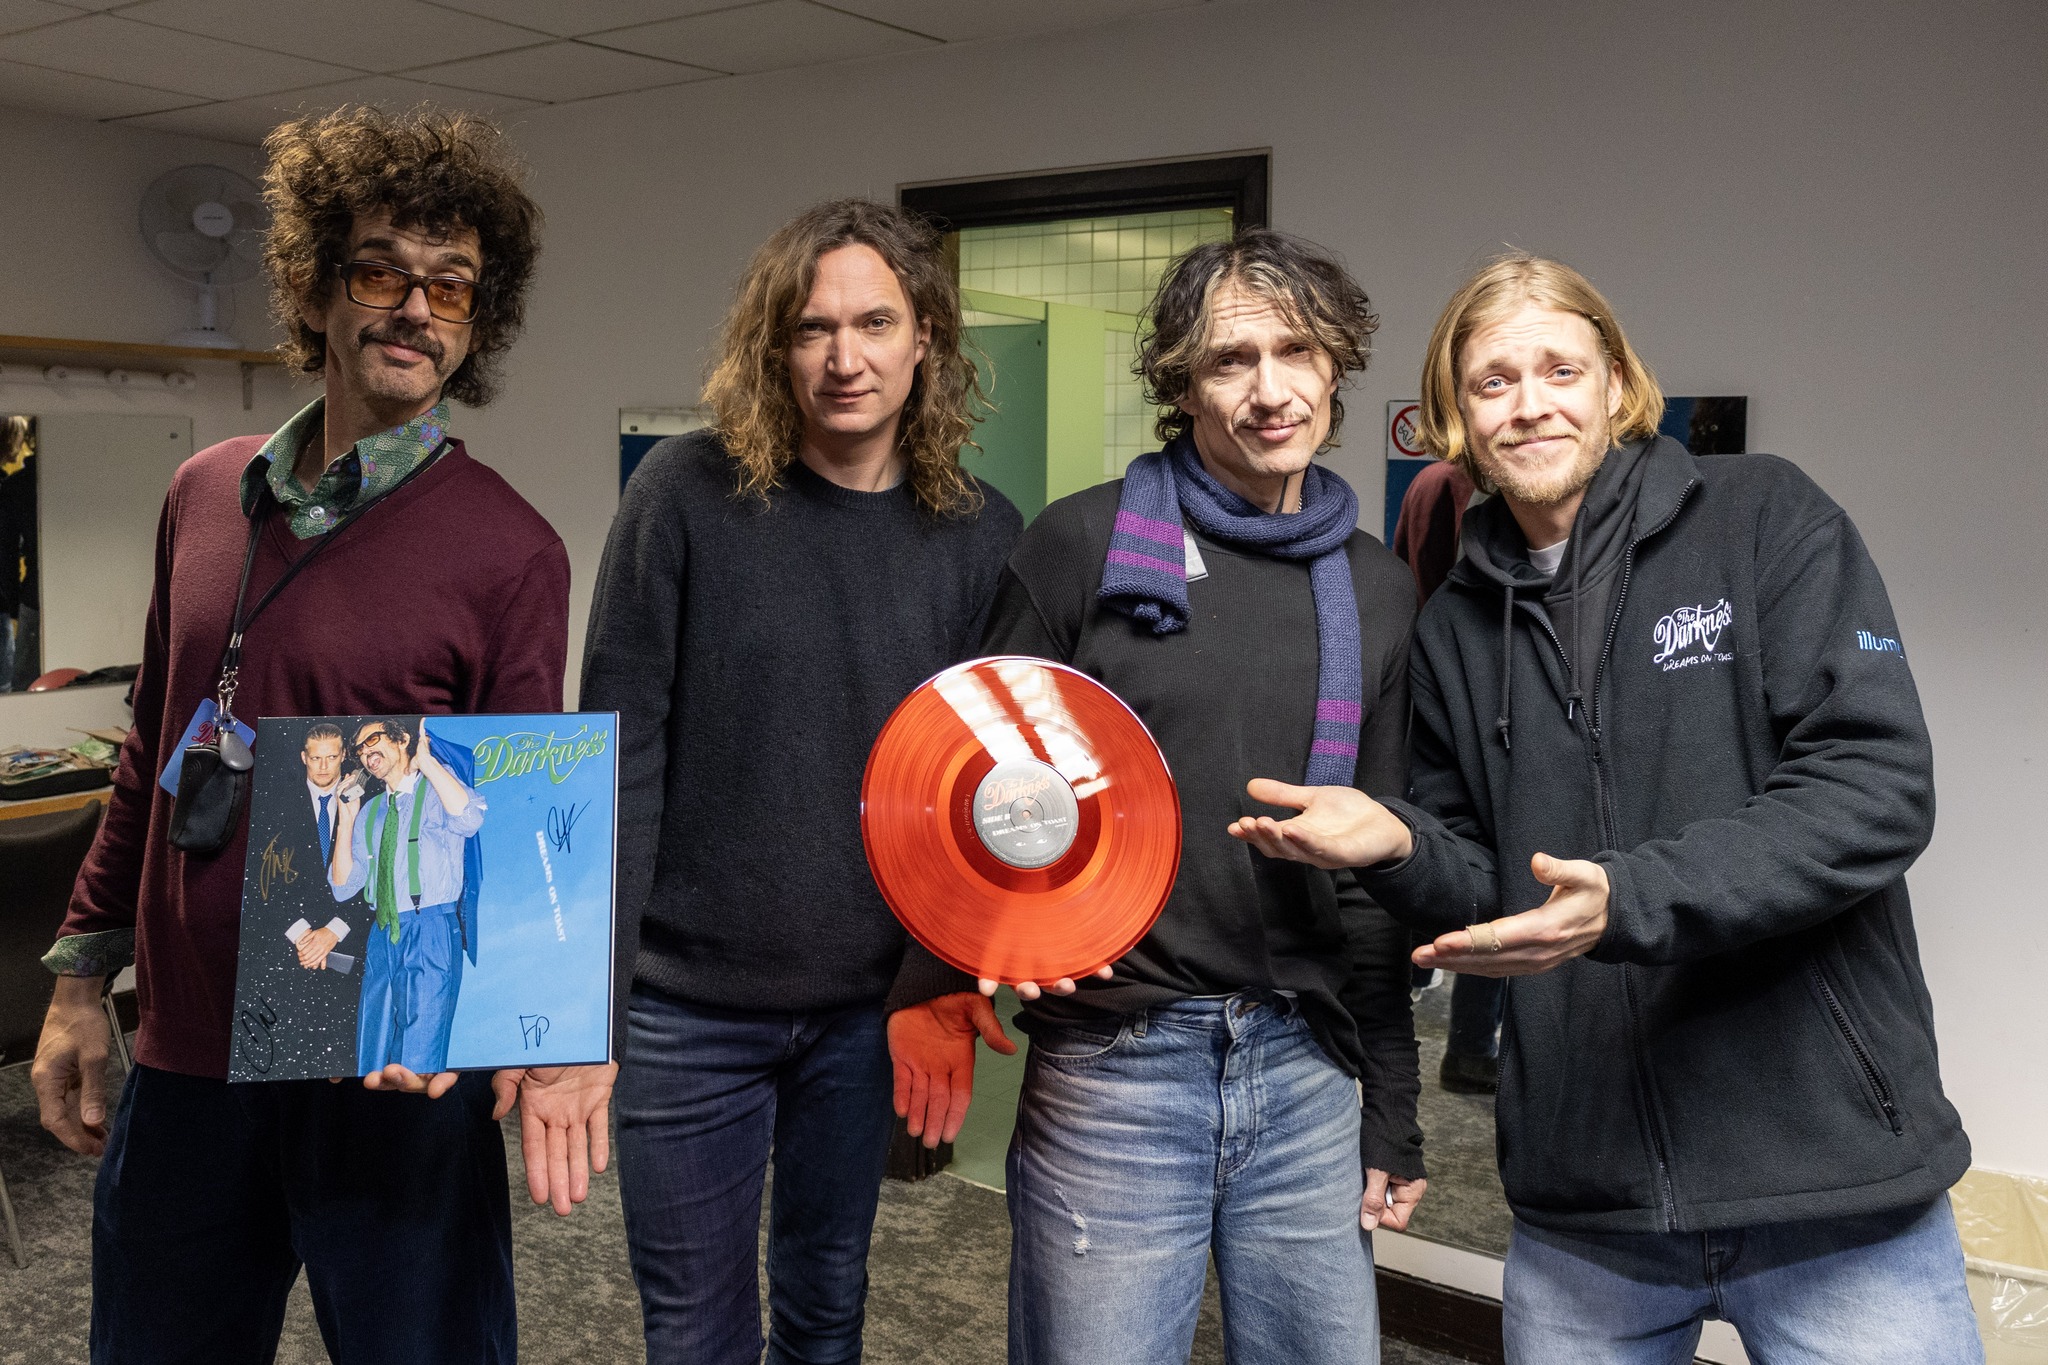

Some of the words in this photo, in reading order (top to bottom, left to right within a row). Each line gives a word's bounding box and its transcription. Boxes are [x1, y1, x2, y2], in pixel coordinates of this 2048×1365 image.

[1676, 609, 1696, 627] The
[1662, 656, 1699, 672] DREAMS
[1701, 654, 1713, 663] ON
[1713, 652, 1734, 662] TOAS
[473, 725, 608, 788] Darkness
[984, 773, 1050, 810] Darkness
[982, 815, 1003, 824] SIDE
[992, 825, 1027, 836] DREAMS
[1042, 817, 1067, 825] TOAST
[536, 830, 553, 883] DREAMS
[548, 885, 558, 905] ON
[553, 904, 567, 942] TOAST
